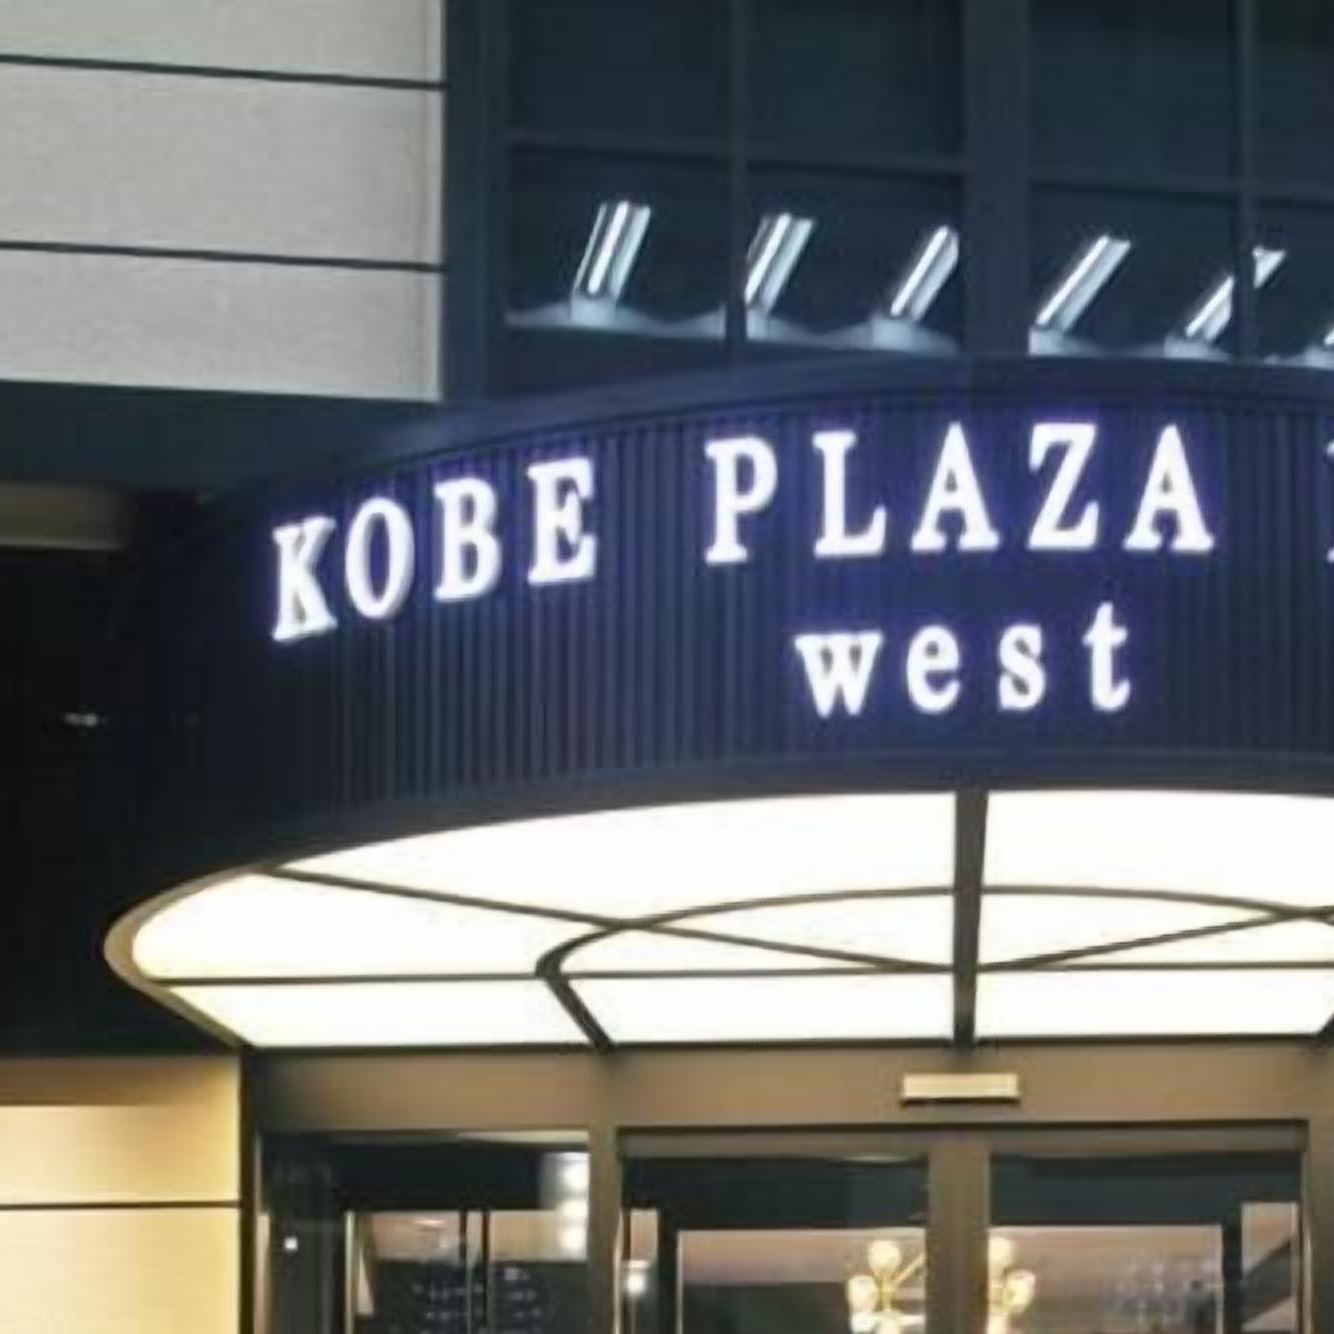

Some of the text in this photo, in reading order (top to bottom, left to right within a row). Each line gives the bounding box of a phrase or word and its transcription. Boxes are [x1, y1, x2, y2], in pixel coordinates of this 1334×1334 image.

[270, 453, 598, 643] KOBE
[702, 420, 1217, 566] PLAZA
[792, 600, 1133, 719] west
